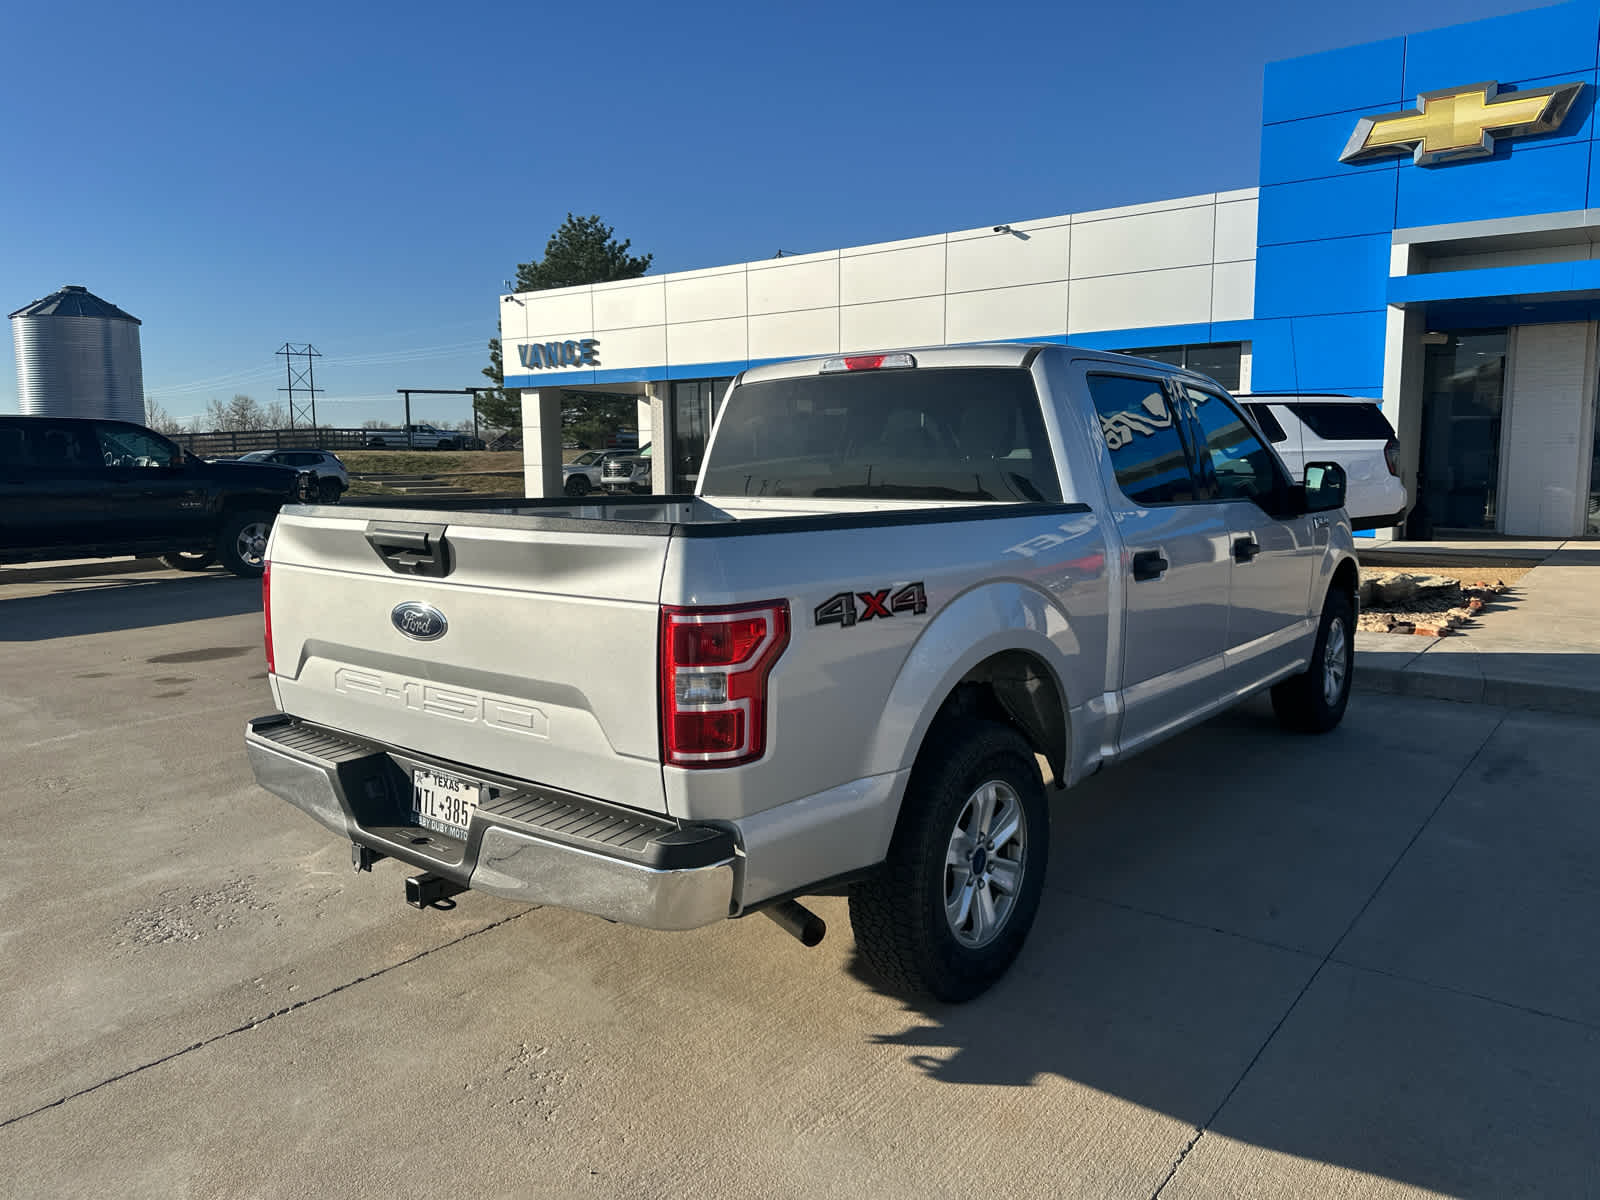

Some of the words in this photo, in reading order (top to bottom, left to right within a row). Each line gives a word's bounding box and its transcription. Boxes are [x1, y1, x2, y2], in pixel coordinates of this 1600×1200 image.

[517, 339, 600, 369] VANCE
[402, 609, 431, 633] Ford
[335, 668, 550, 740] F-150
[433, 774, 460, 792] TEXAS
